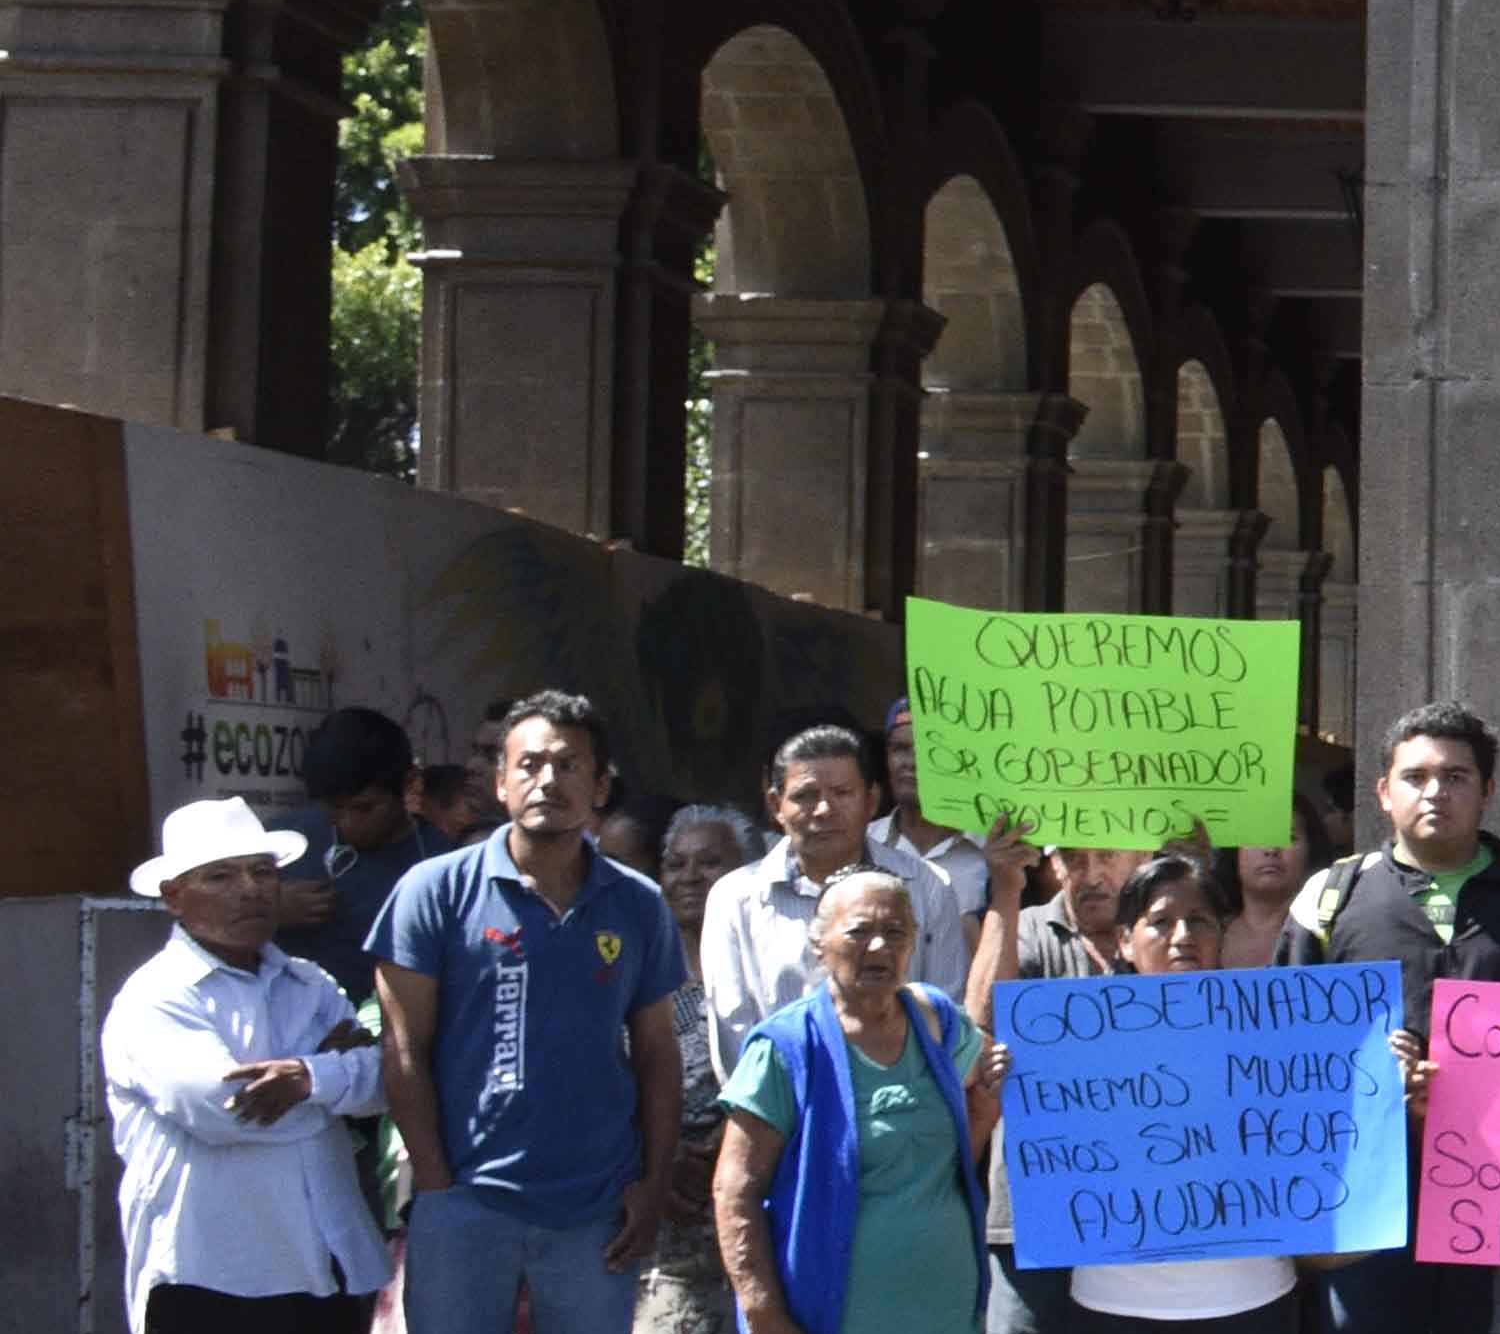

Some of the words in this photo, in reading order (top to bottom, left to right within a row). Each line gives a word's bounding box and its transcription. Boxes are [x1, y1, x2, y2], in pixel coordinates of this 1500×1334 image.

[974, 614, 1248, 683] QUEREMOS
[913, 667, 1014, 733] AGUA
[1048, 679, 1240, 734] POTABLE
[993, 740, 1267, 786] GOBERNADOR
[1010, 968, 1393, 1045] GOBERNADOR
[1008, 1064, 1191, 1116] TENEMOS
[1226, 1047, 1380, 1099] MUCHOS
[1017, 1135, 1120, 1178] AÑOS
[1137, 1121, 1218, 1166] SIN
[1237, 1107, 1360, 1158] AGUA
[1068, 1162, 1350, 1248] AYUDANOS
